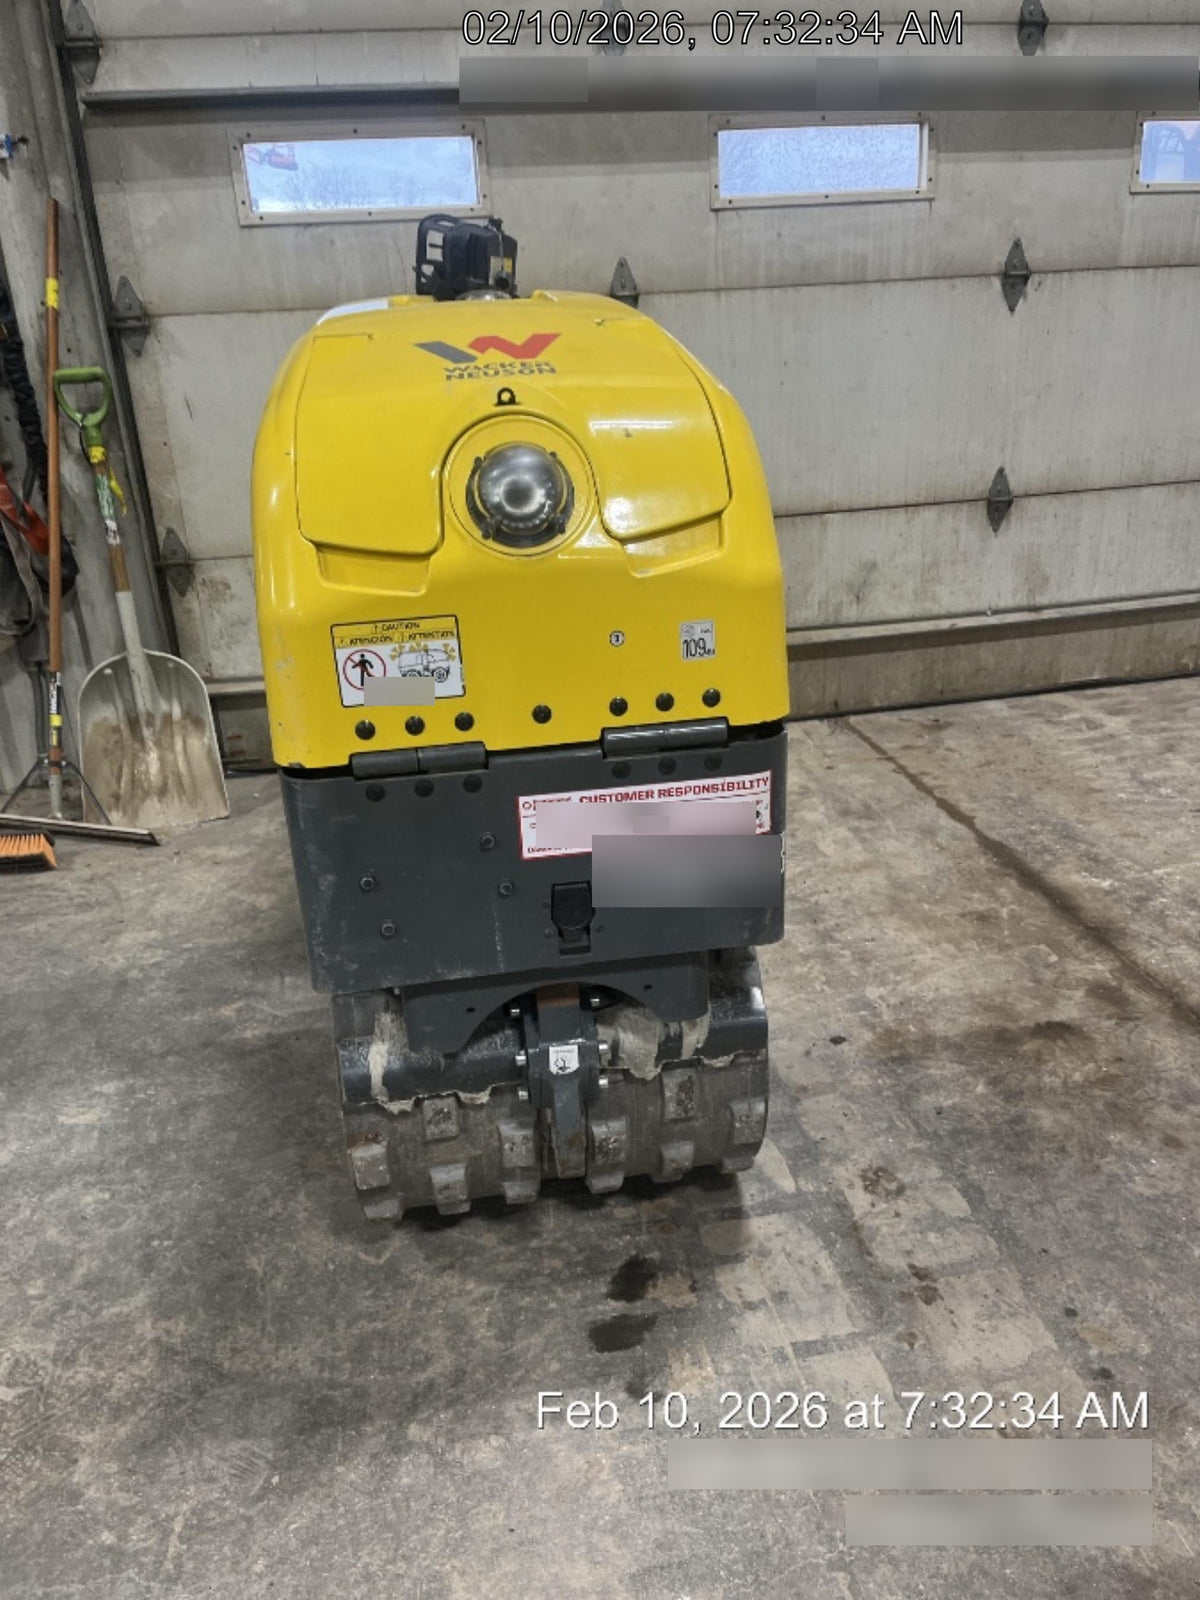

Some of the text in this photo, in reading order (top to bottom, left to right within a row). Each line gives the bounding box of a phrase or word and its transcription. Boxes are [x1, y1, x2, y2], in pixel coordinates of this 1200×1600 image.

[444, 361, 553, 373] WACKER
[446, 366, 557, 381] NEUSON
[381, 622, 420, 632] CAUTION
[682, 637, 707, 659] 109
[579, 776, 769, 803] CUSTOMER RESPONSIBILITY
